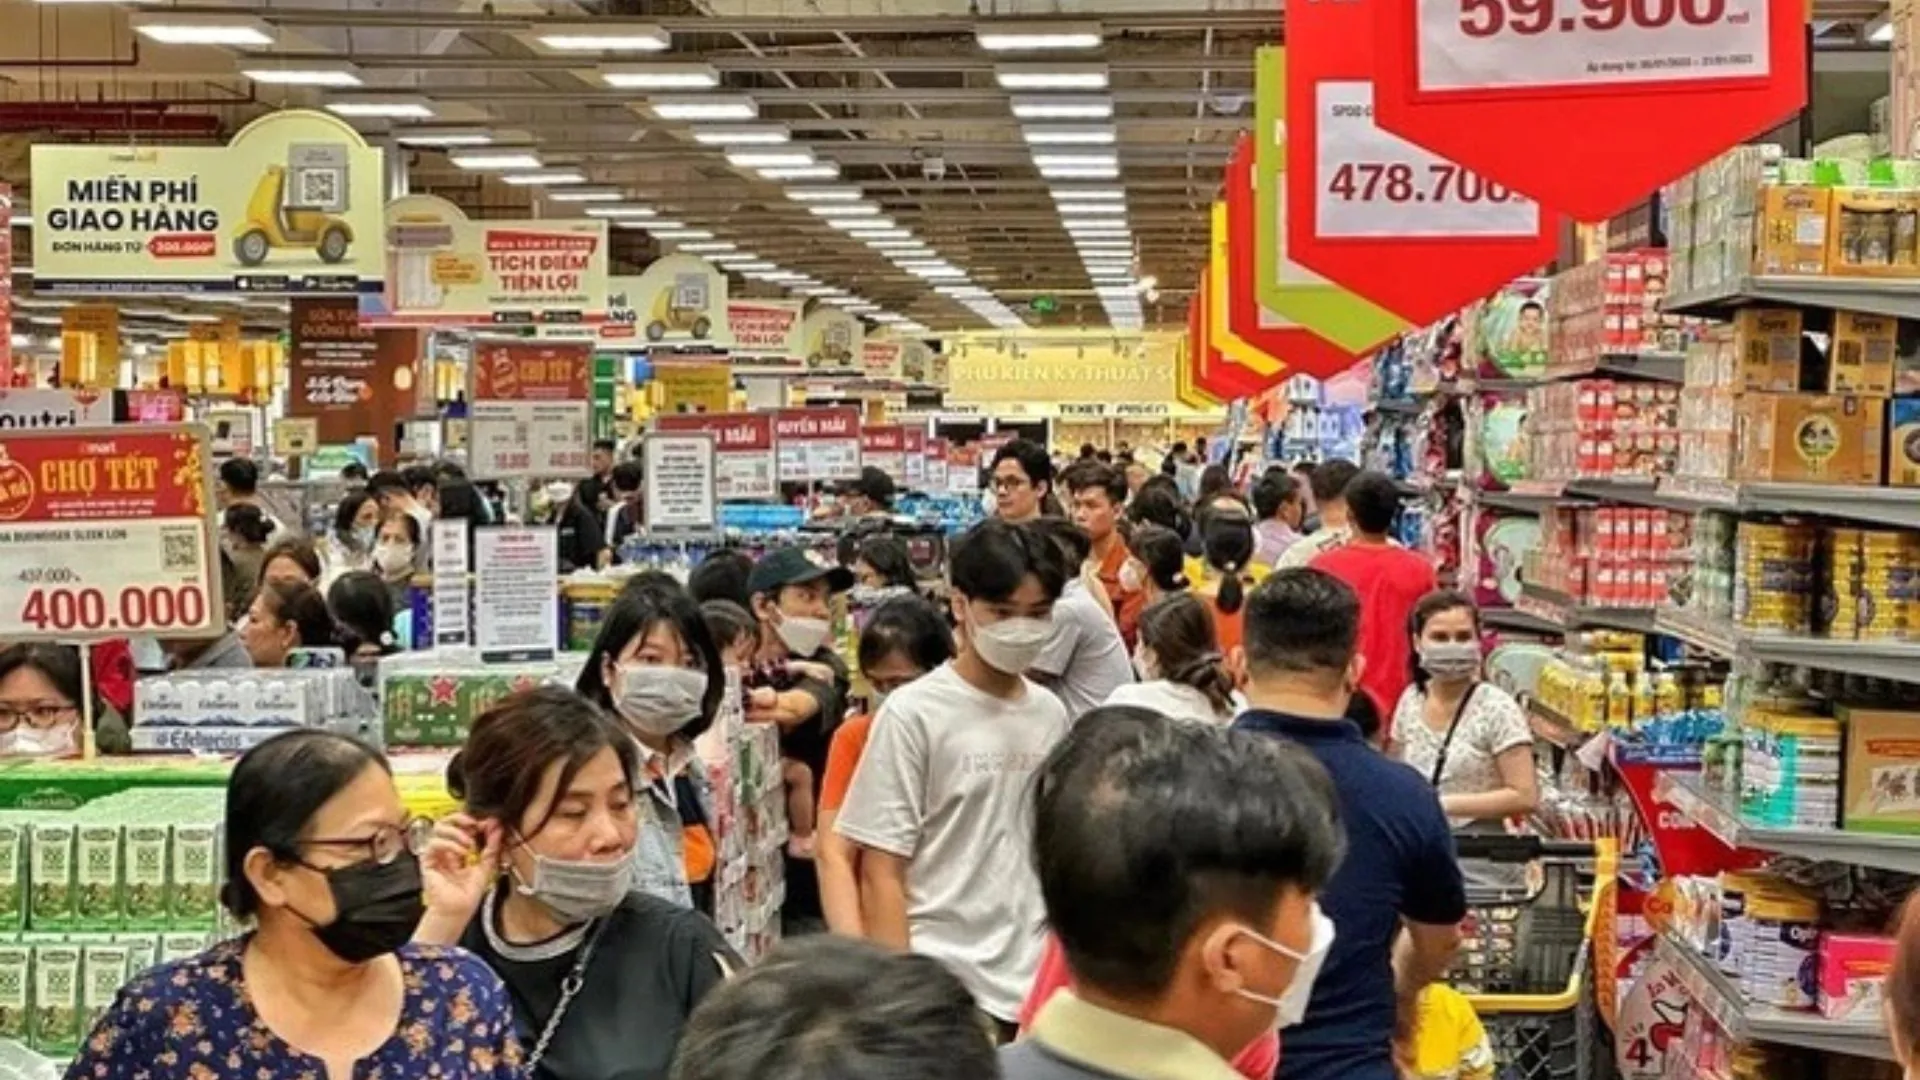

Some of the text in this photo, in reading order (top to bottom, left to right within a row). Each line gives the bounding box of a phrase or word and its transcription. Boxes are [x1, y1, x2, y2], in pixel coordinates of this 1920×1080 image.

[150, 174, 198, 203] PHÍ
[47, 203, 219, 231] GIAO HÀNG
[41, 456, 97, 498] CHỢ
[104, 450, 159, 491] TẾT
[21, 585, 205, 630] 400.000
